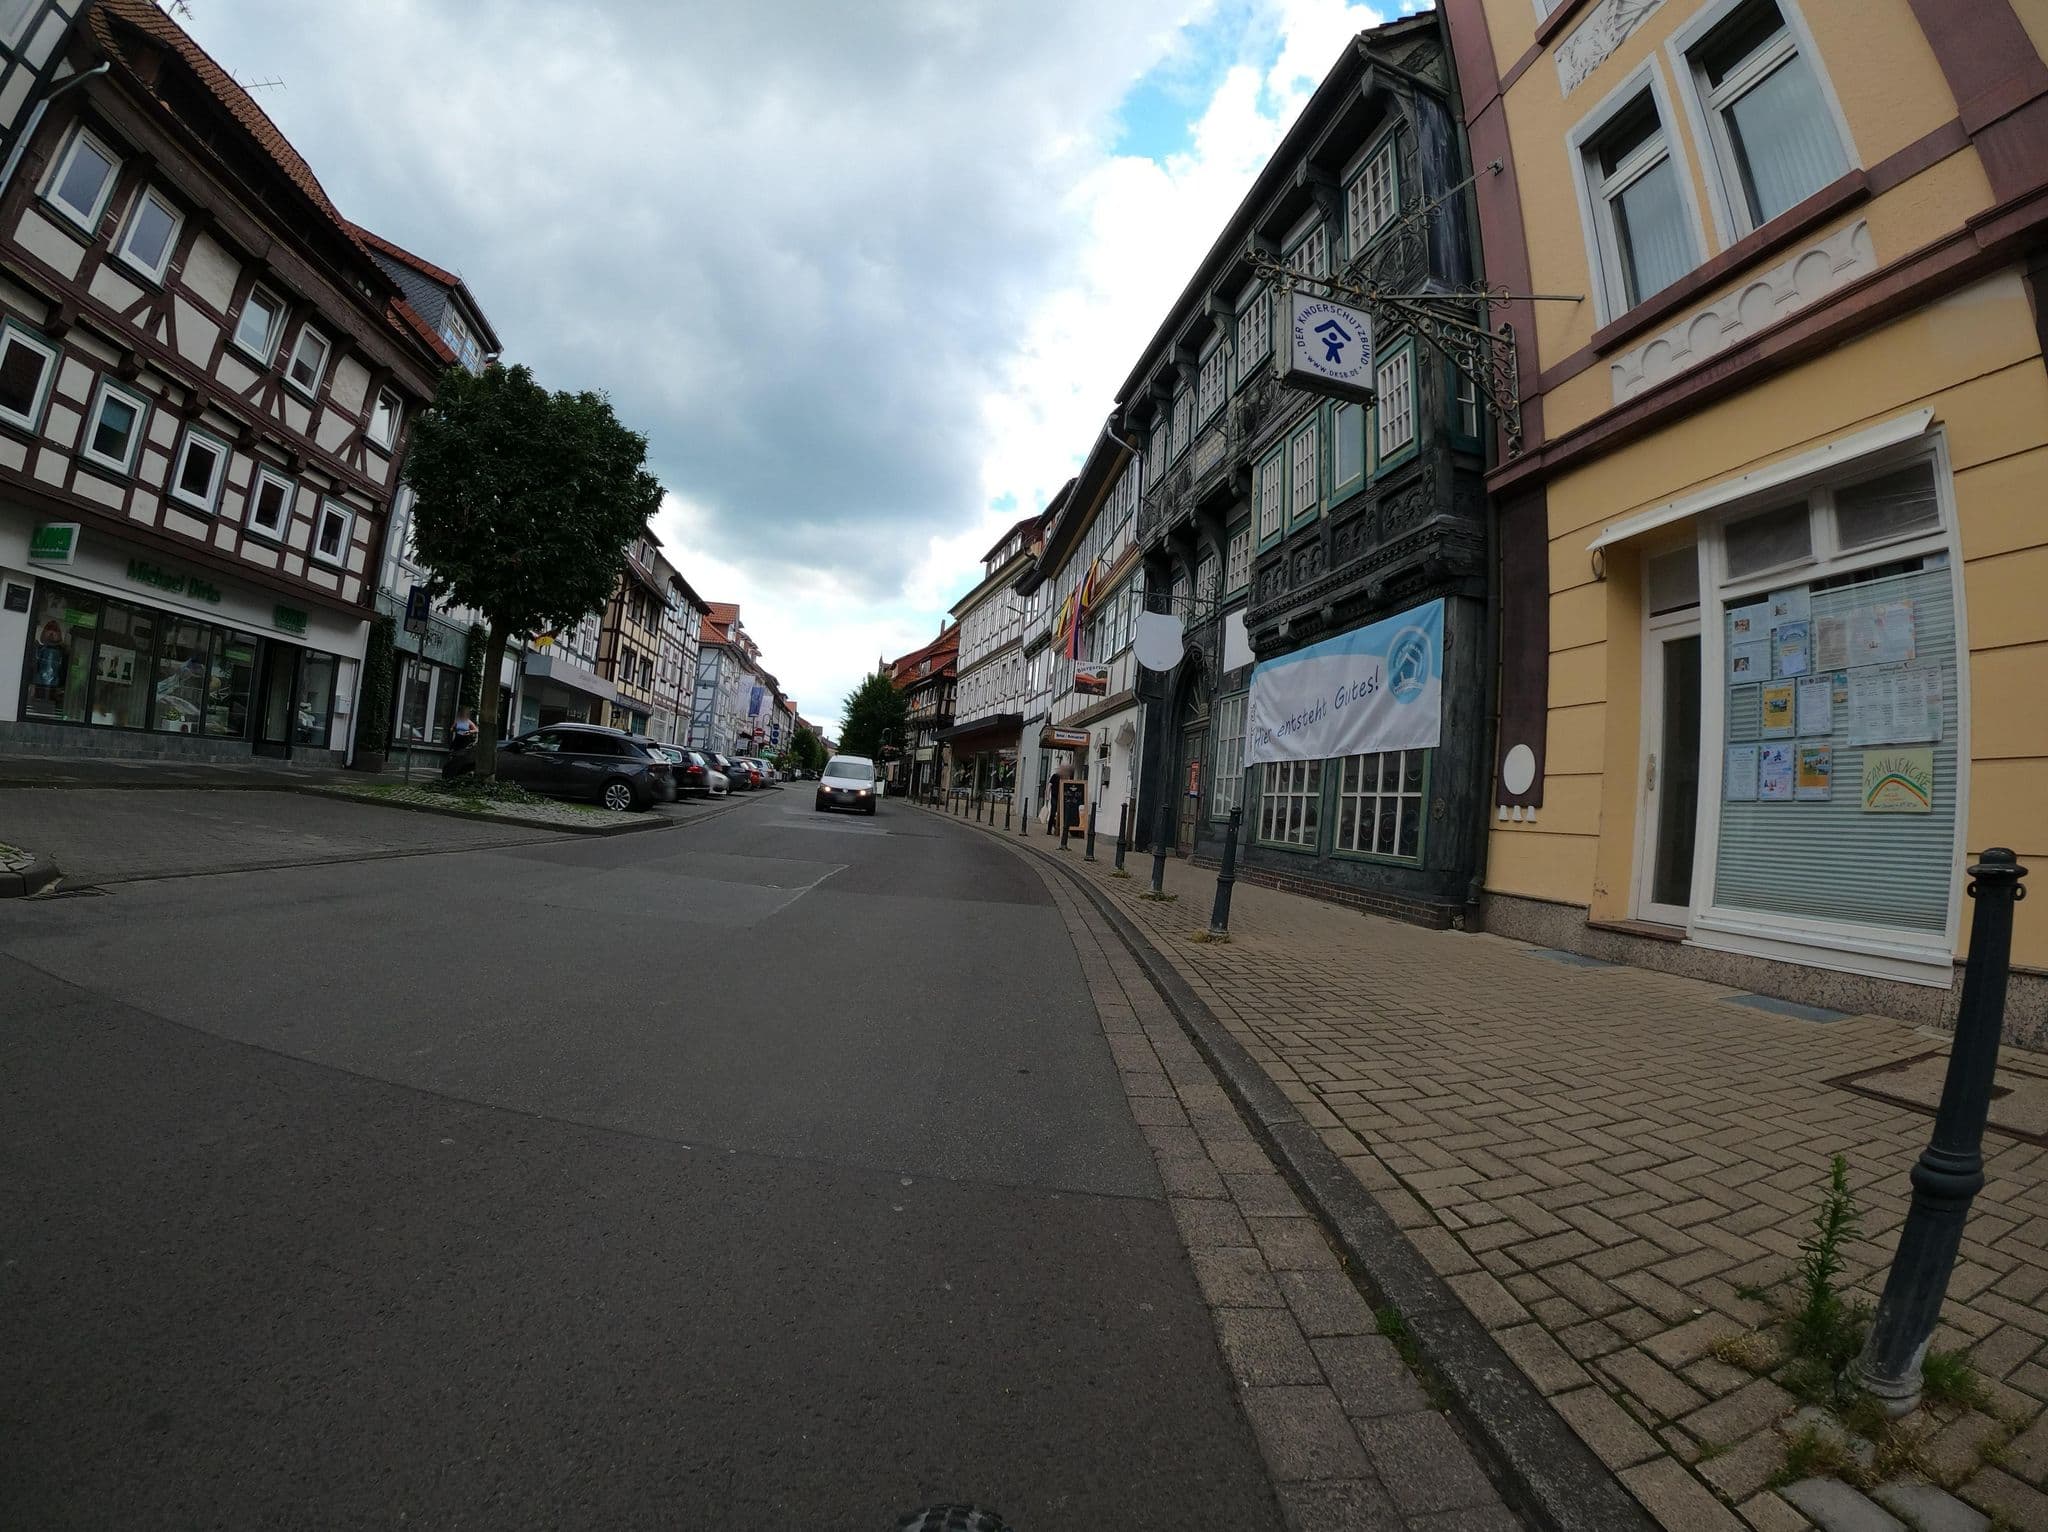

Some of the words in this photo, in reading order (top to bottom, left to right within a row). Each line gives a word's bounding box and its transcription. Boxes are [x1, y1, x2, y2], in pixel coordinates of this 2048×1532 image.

[1295, 326, 1306, 347] DER
[1297, 303, 1371, 365] KINDERSCHUTZBUND
[410, 591, 426, 619] P
[1254, 727, 1272, 747] Hier
[1277, 698, 1328, 738] entsteht
[1334, 664, 1380, 710] Gutes!
